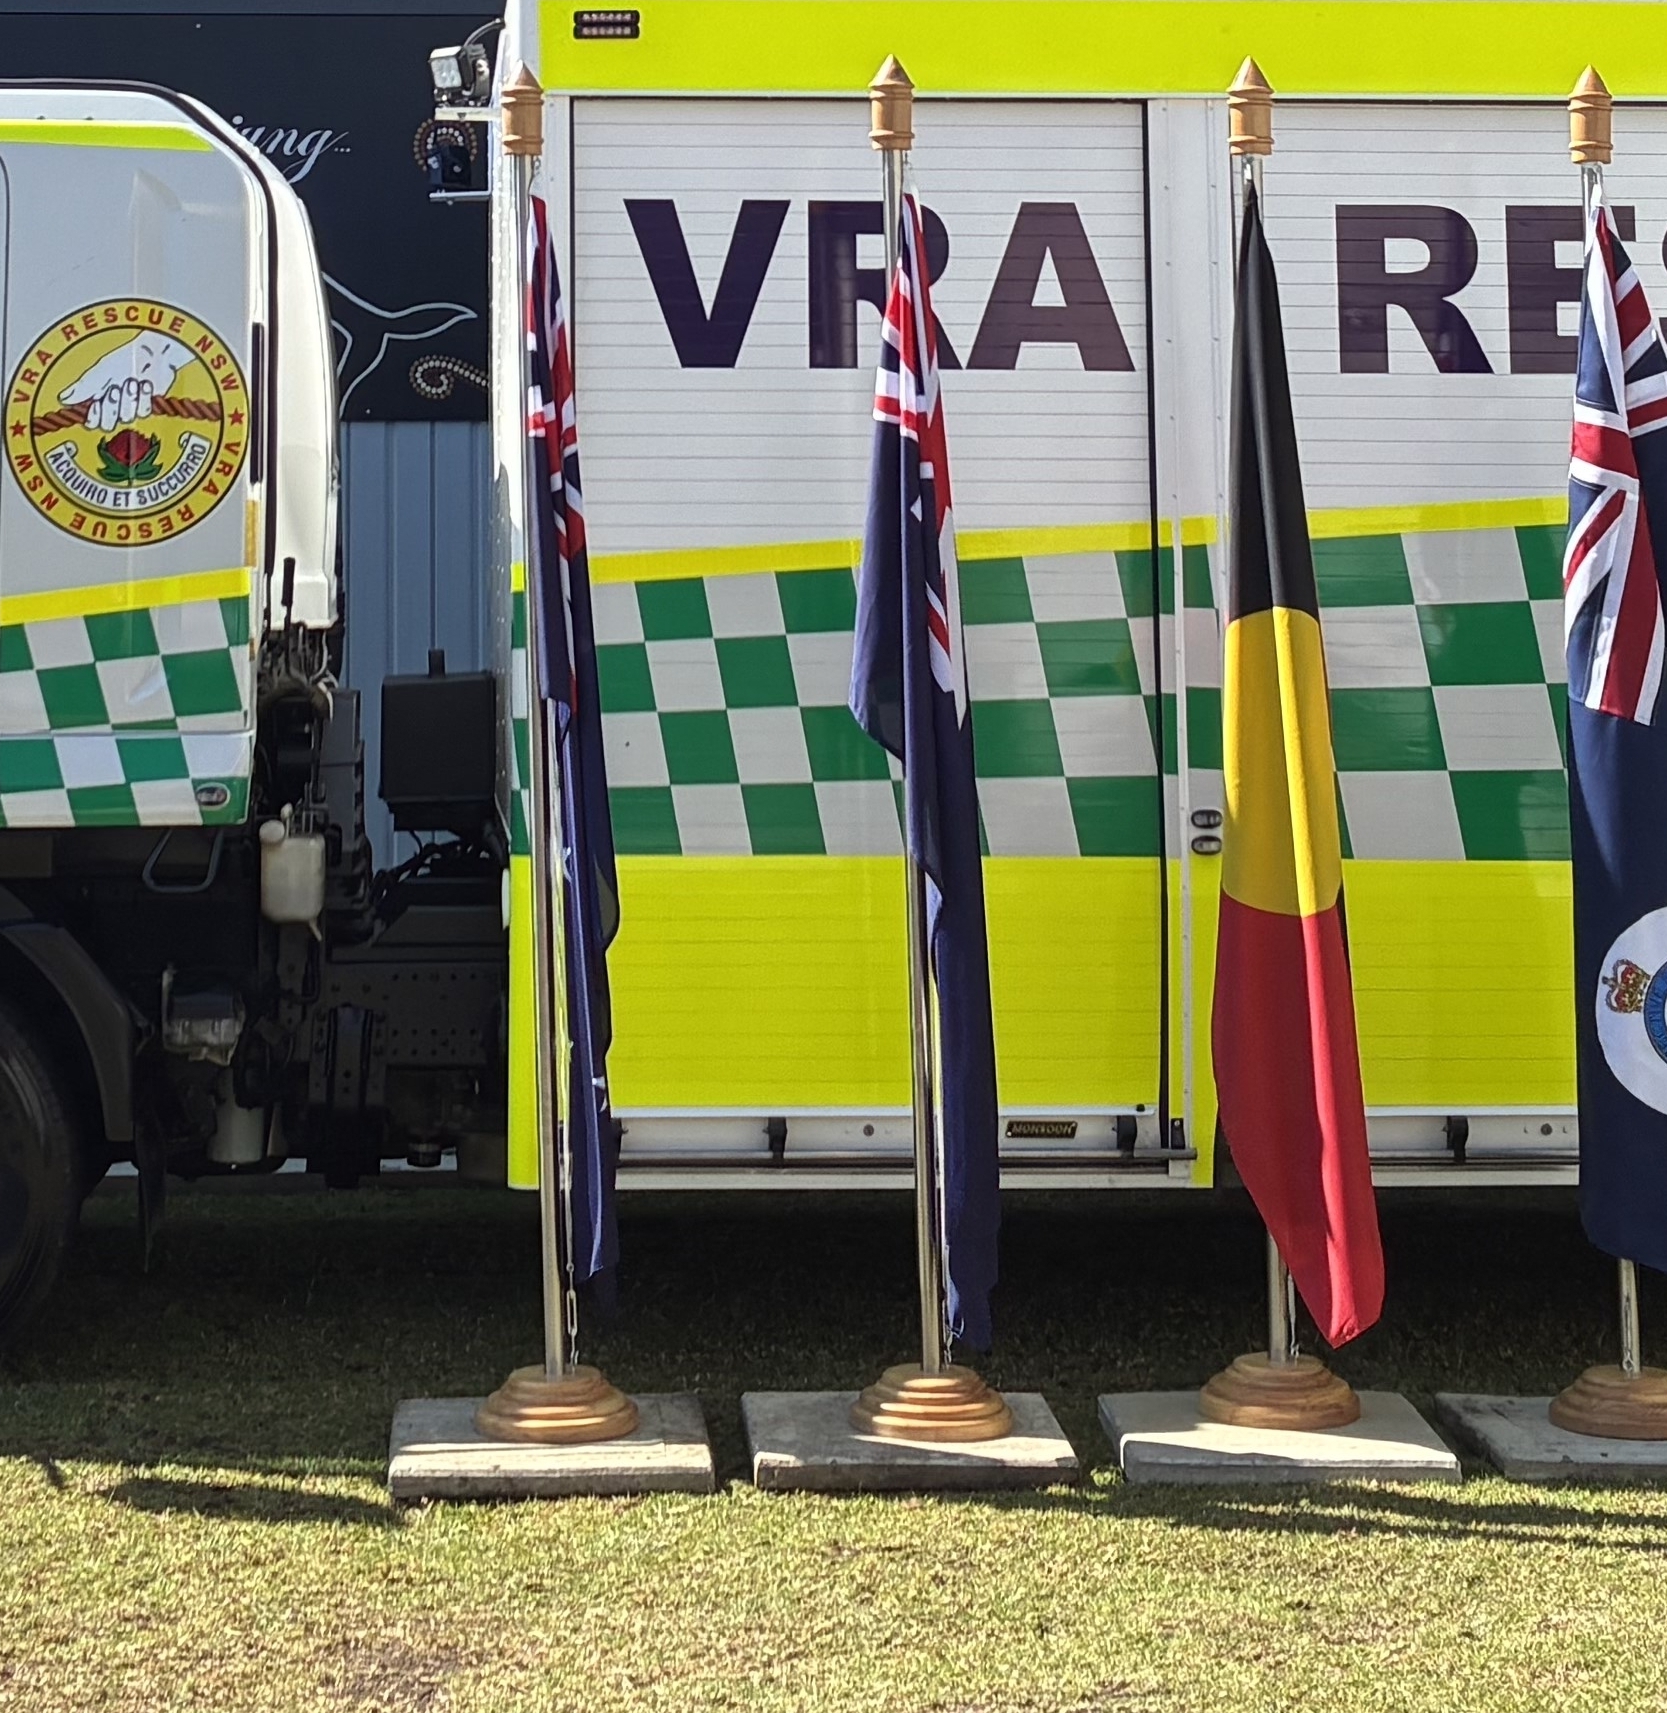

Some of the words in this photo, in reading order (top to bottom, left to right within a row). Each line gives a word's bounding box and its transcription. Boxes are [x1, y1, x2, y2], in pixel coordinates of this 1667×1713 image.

[623, 198, 1136, 372] VRA
[13, 348, 54, 404] VRA
[60, 305, 186, 342] RESCUE
[194, 334, 239, 391] NSW
[14, 453, 60, 511] NSW
[112, 490, 132, 508] ET
[137, 442, 207, 506] SUCCURRO
[201, 441, 241, 498] VRA
[69, 504, 195, 541] RESCUE
